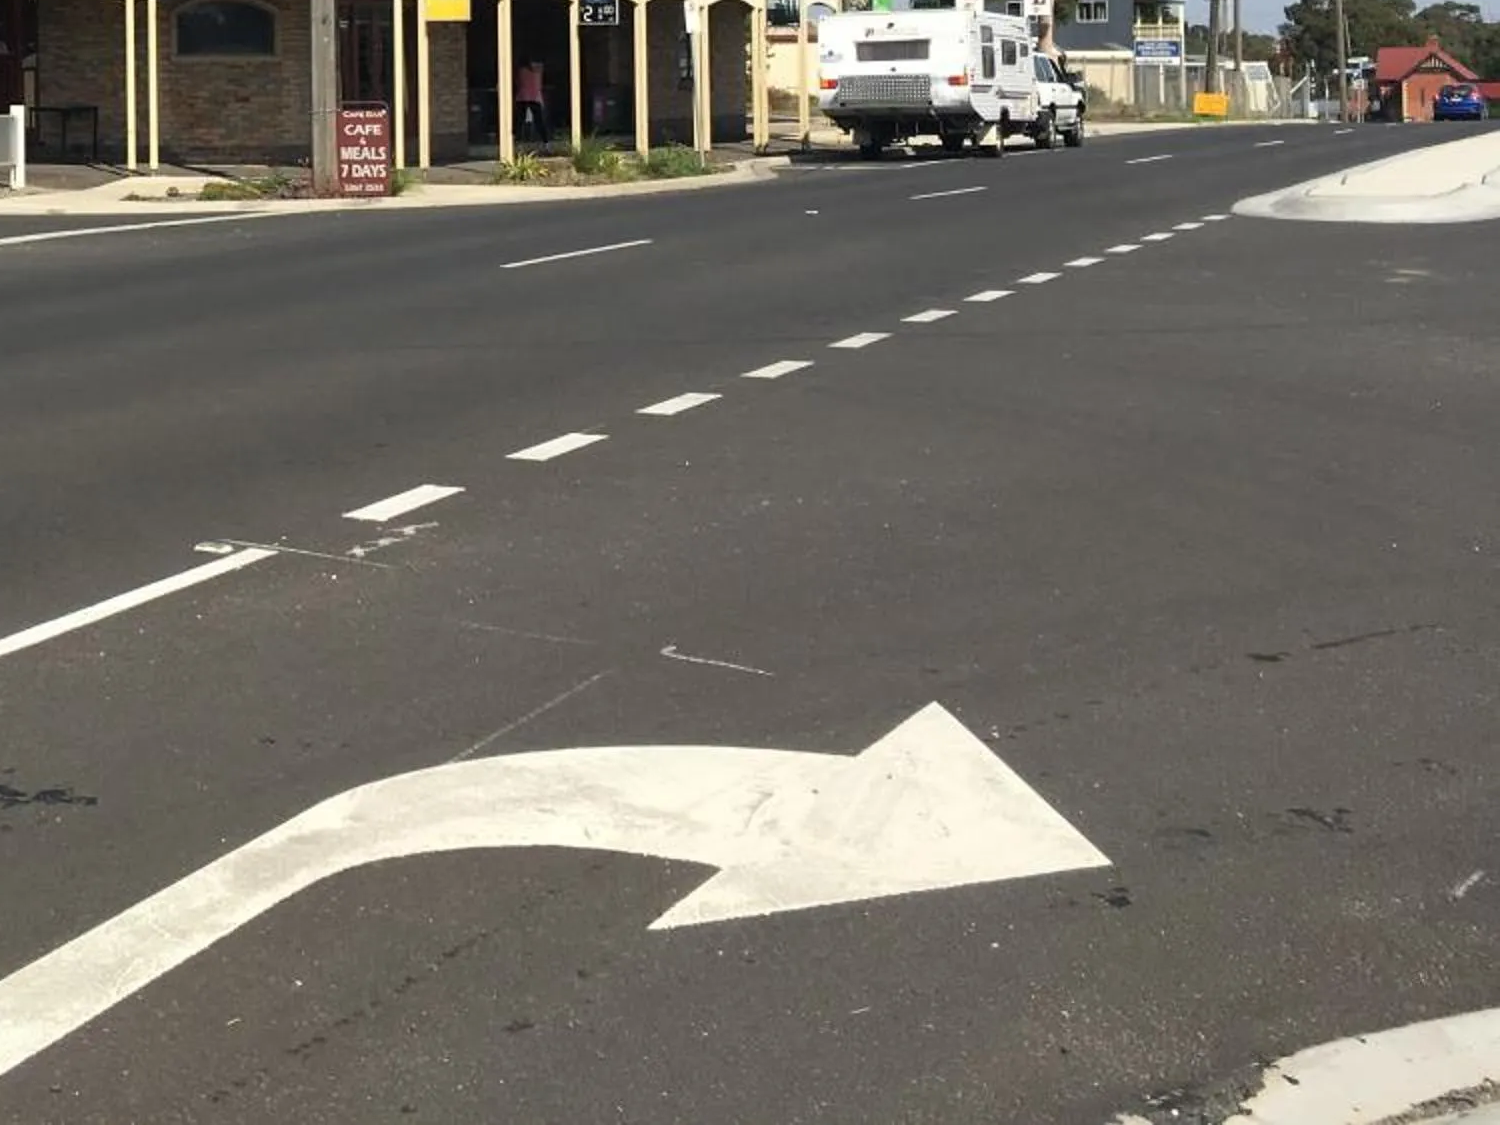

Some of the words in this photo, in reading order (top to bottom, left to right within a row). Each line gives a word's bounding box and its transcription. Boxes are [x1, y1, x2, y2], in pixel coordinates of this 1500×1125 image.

[343, 124, 382, 136] CAFE
[340, 146, 387, 160] MEALS
[340, 164, 349, 178] 7
[351, 164, 387, 178] DAYS
